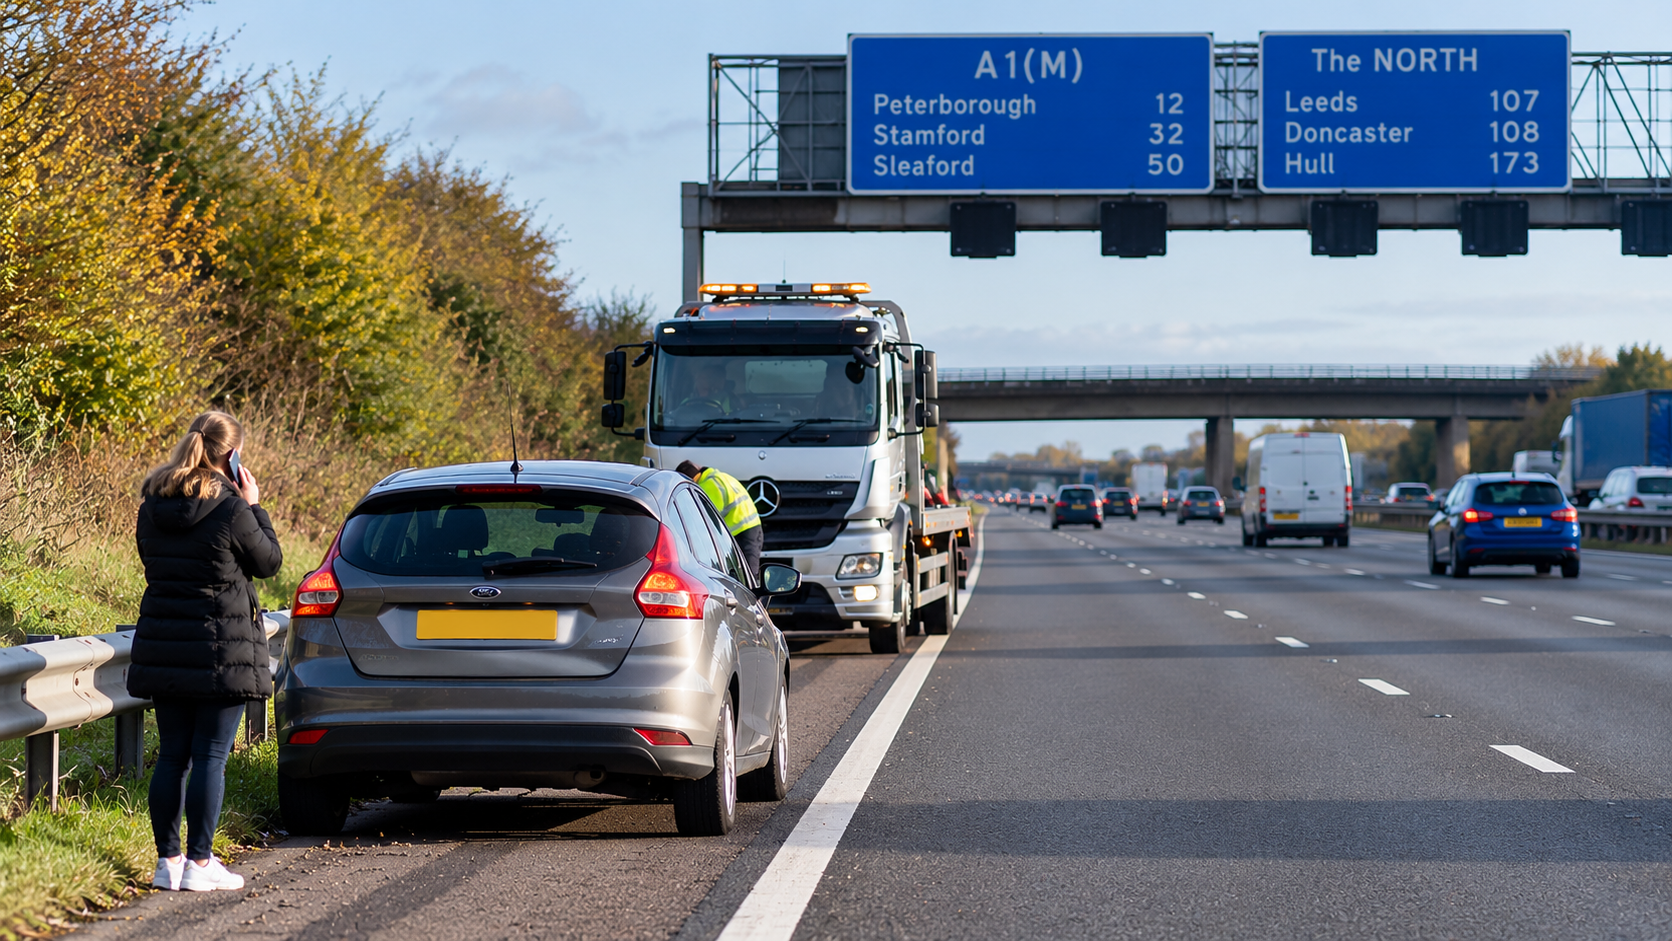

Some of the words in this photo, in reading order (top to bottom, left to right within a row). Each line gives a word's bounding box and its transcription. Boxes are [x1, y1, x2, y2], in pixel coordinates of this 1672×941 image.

[1312, 48, 1361, 72] The
[1374, 47, 1477, 72] NORTH
[874, 93, 1036, 120] Peterborough
[1156, 92, 1184, 114] 12
[1285, 90, 1358, 113] Leeds
[1490, 89, 1540, 112] 107
[873, 123, 985, 146] Stamford
[1149, 122, 1183, 145] 32
[1285, 121, 1413, 143] Doncaster
[1489, 120, 1540, 143] 108
[873, 154, 974, 176] Sleaford
[1148, 153, 1184, 176] 50
[1285, 152, 1335, 174] Hull
[1489, 151, 1539, 174] 173
